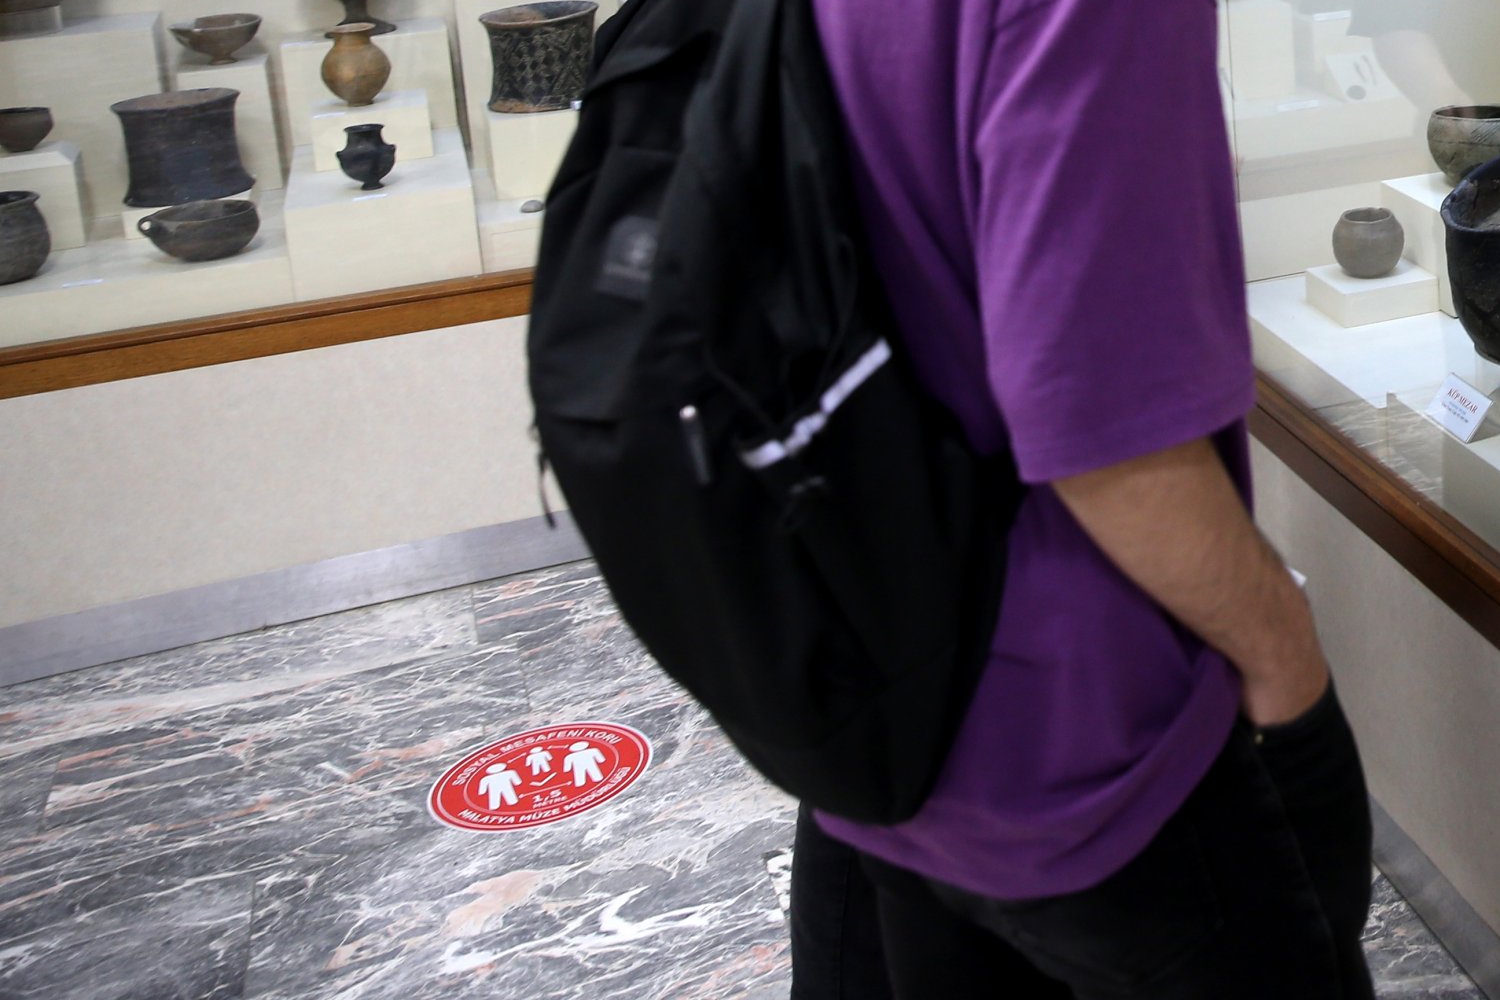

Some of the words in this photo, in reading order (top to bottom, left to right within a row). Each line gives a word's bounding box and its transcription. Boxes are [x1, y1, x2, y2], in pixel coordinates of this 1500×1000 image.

[452, 753, 500, 785] SOSYAL
[500, 728, 585, 752] MESAFENİ
[585, 730, 623, 744] KORU
[458, 808, 515, 824] MALATYA
[519, 808, 561, 822] MÜZE
